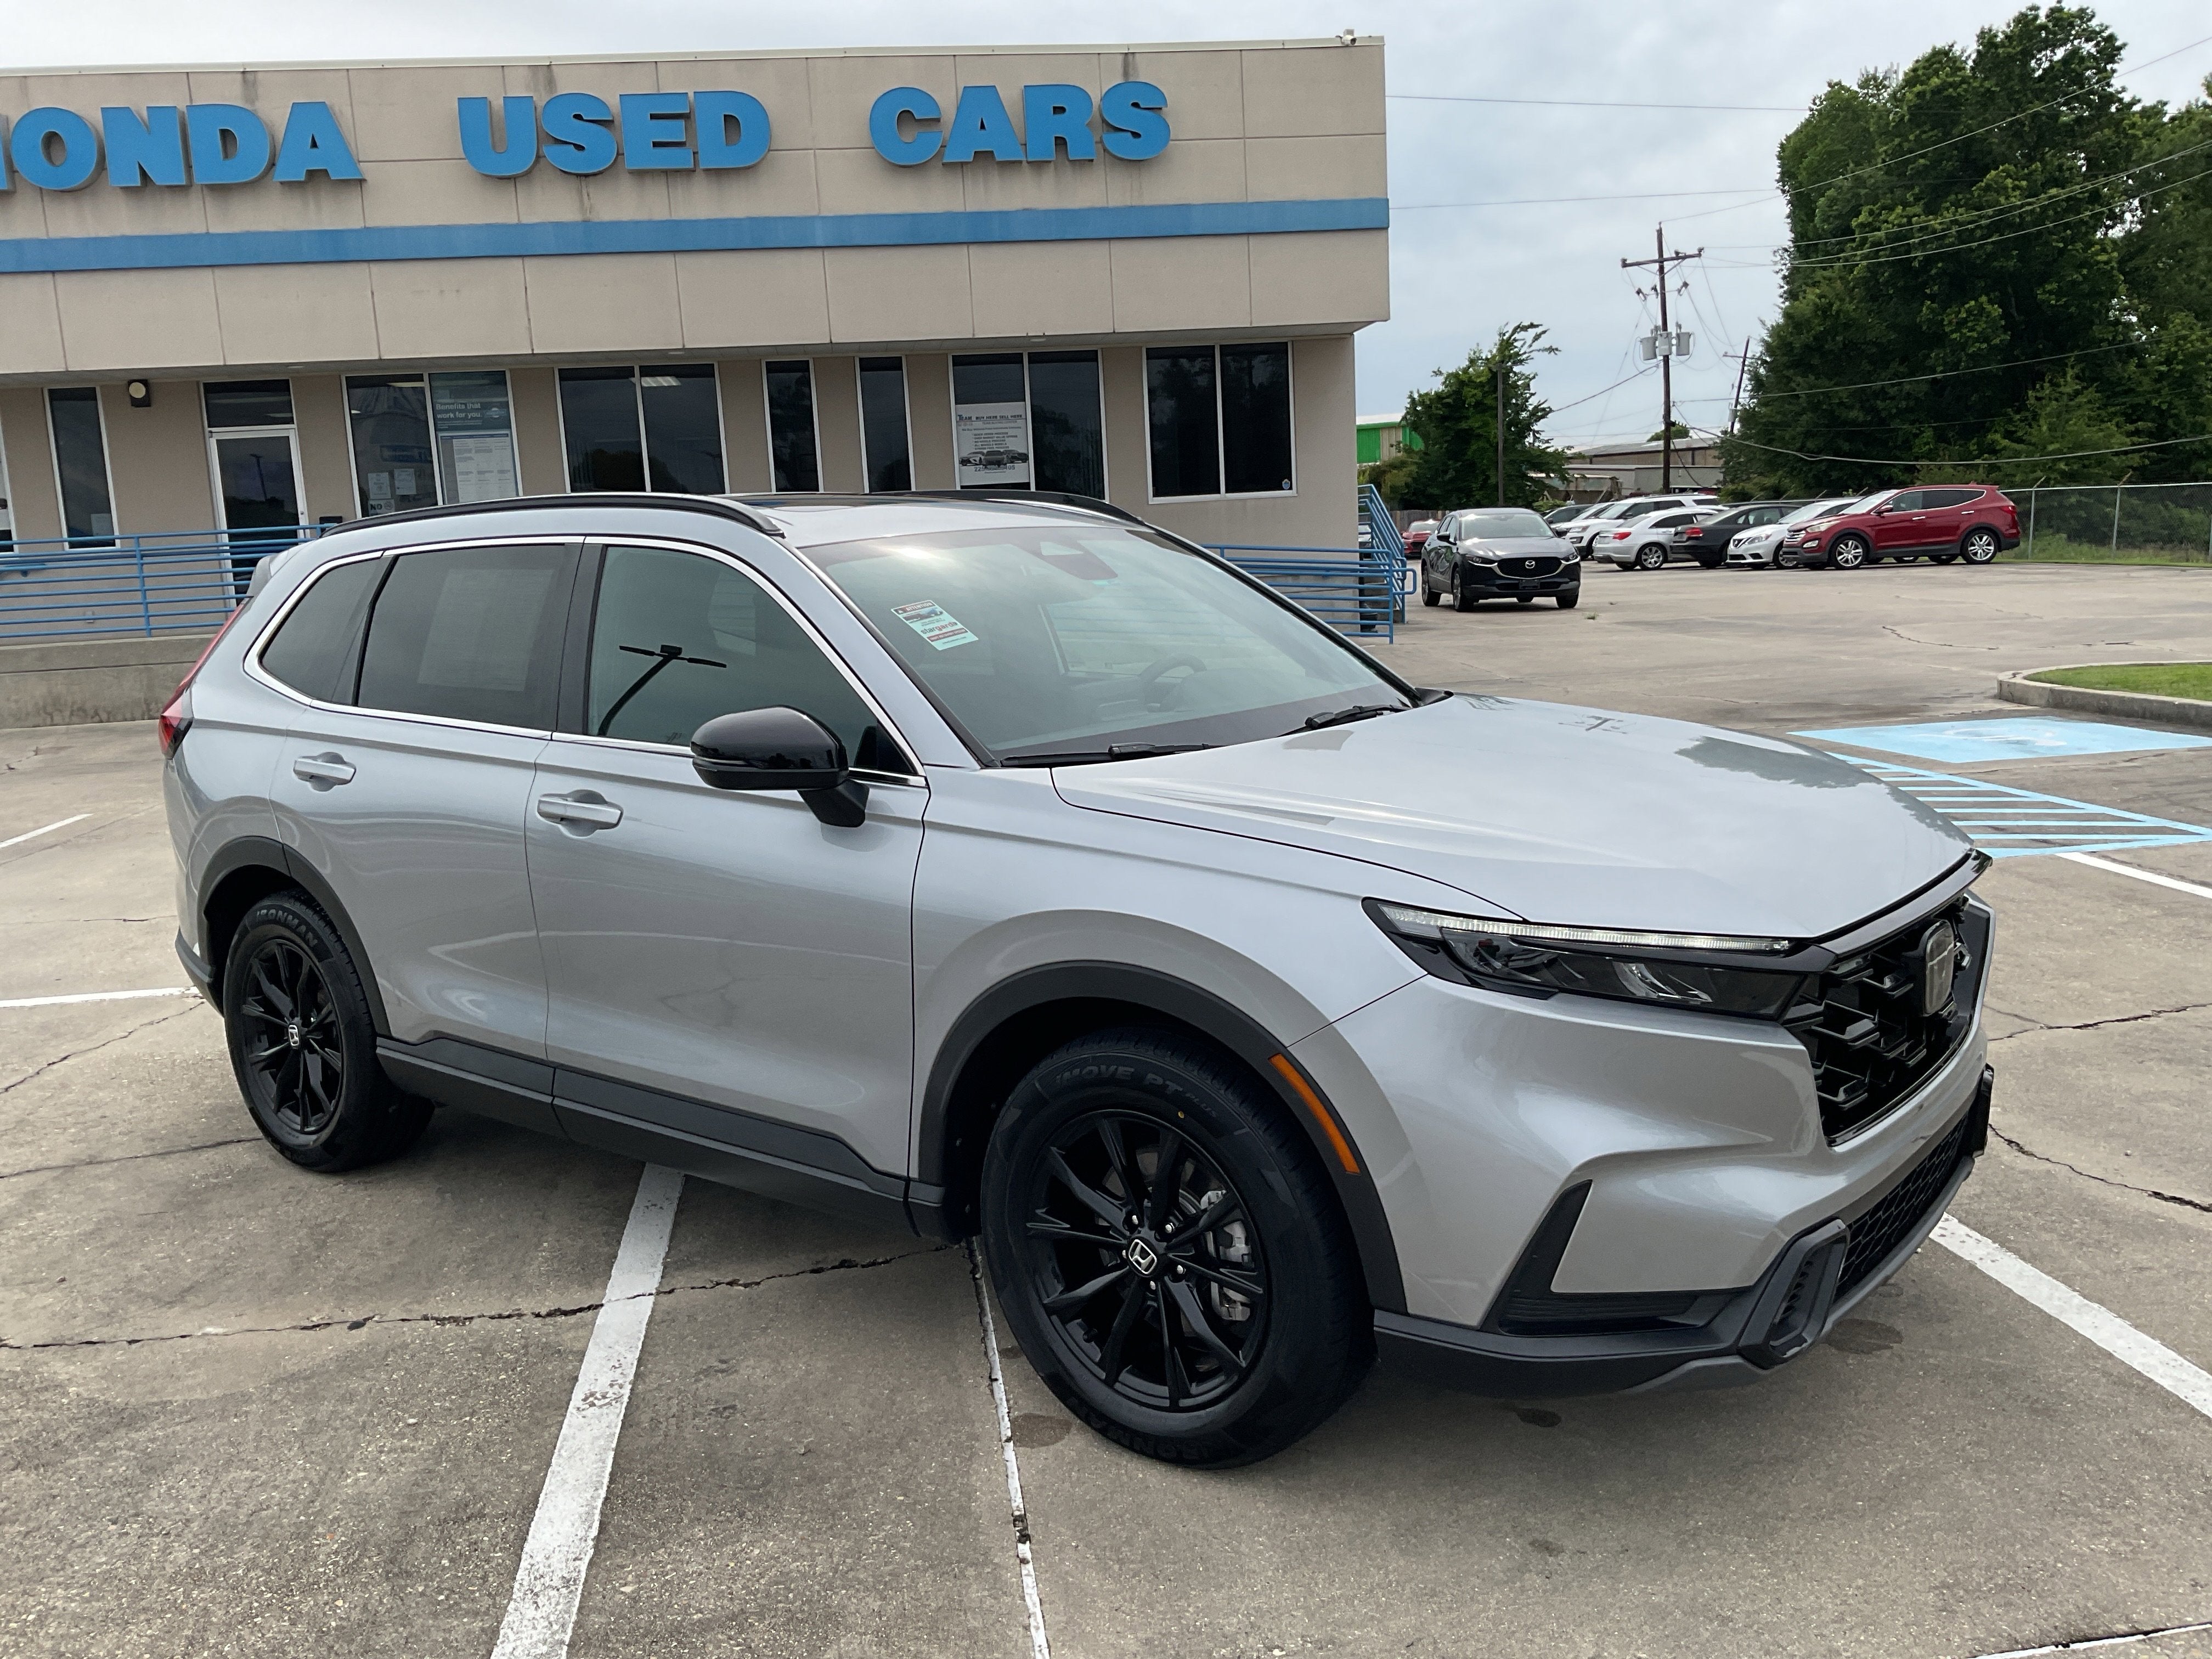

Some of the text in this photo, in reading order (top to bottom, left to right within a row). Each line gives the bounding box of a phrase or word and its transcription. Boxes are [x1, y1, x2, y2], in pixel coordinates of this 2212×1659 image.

[0, 81, 1171, 191] ONDA USED CARS
[906, 602, 933, 611] ATTENTION
[256, 909, 318, 947] IRONMAN
[1143, 1073, 1183, 1095] PT
